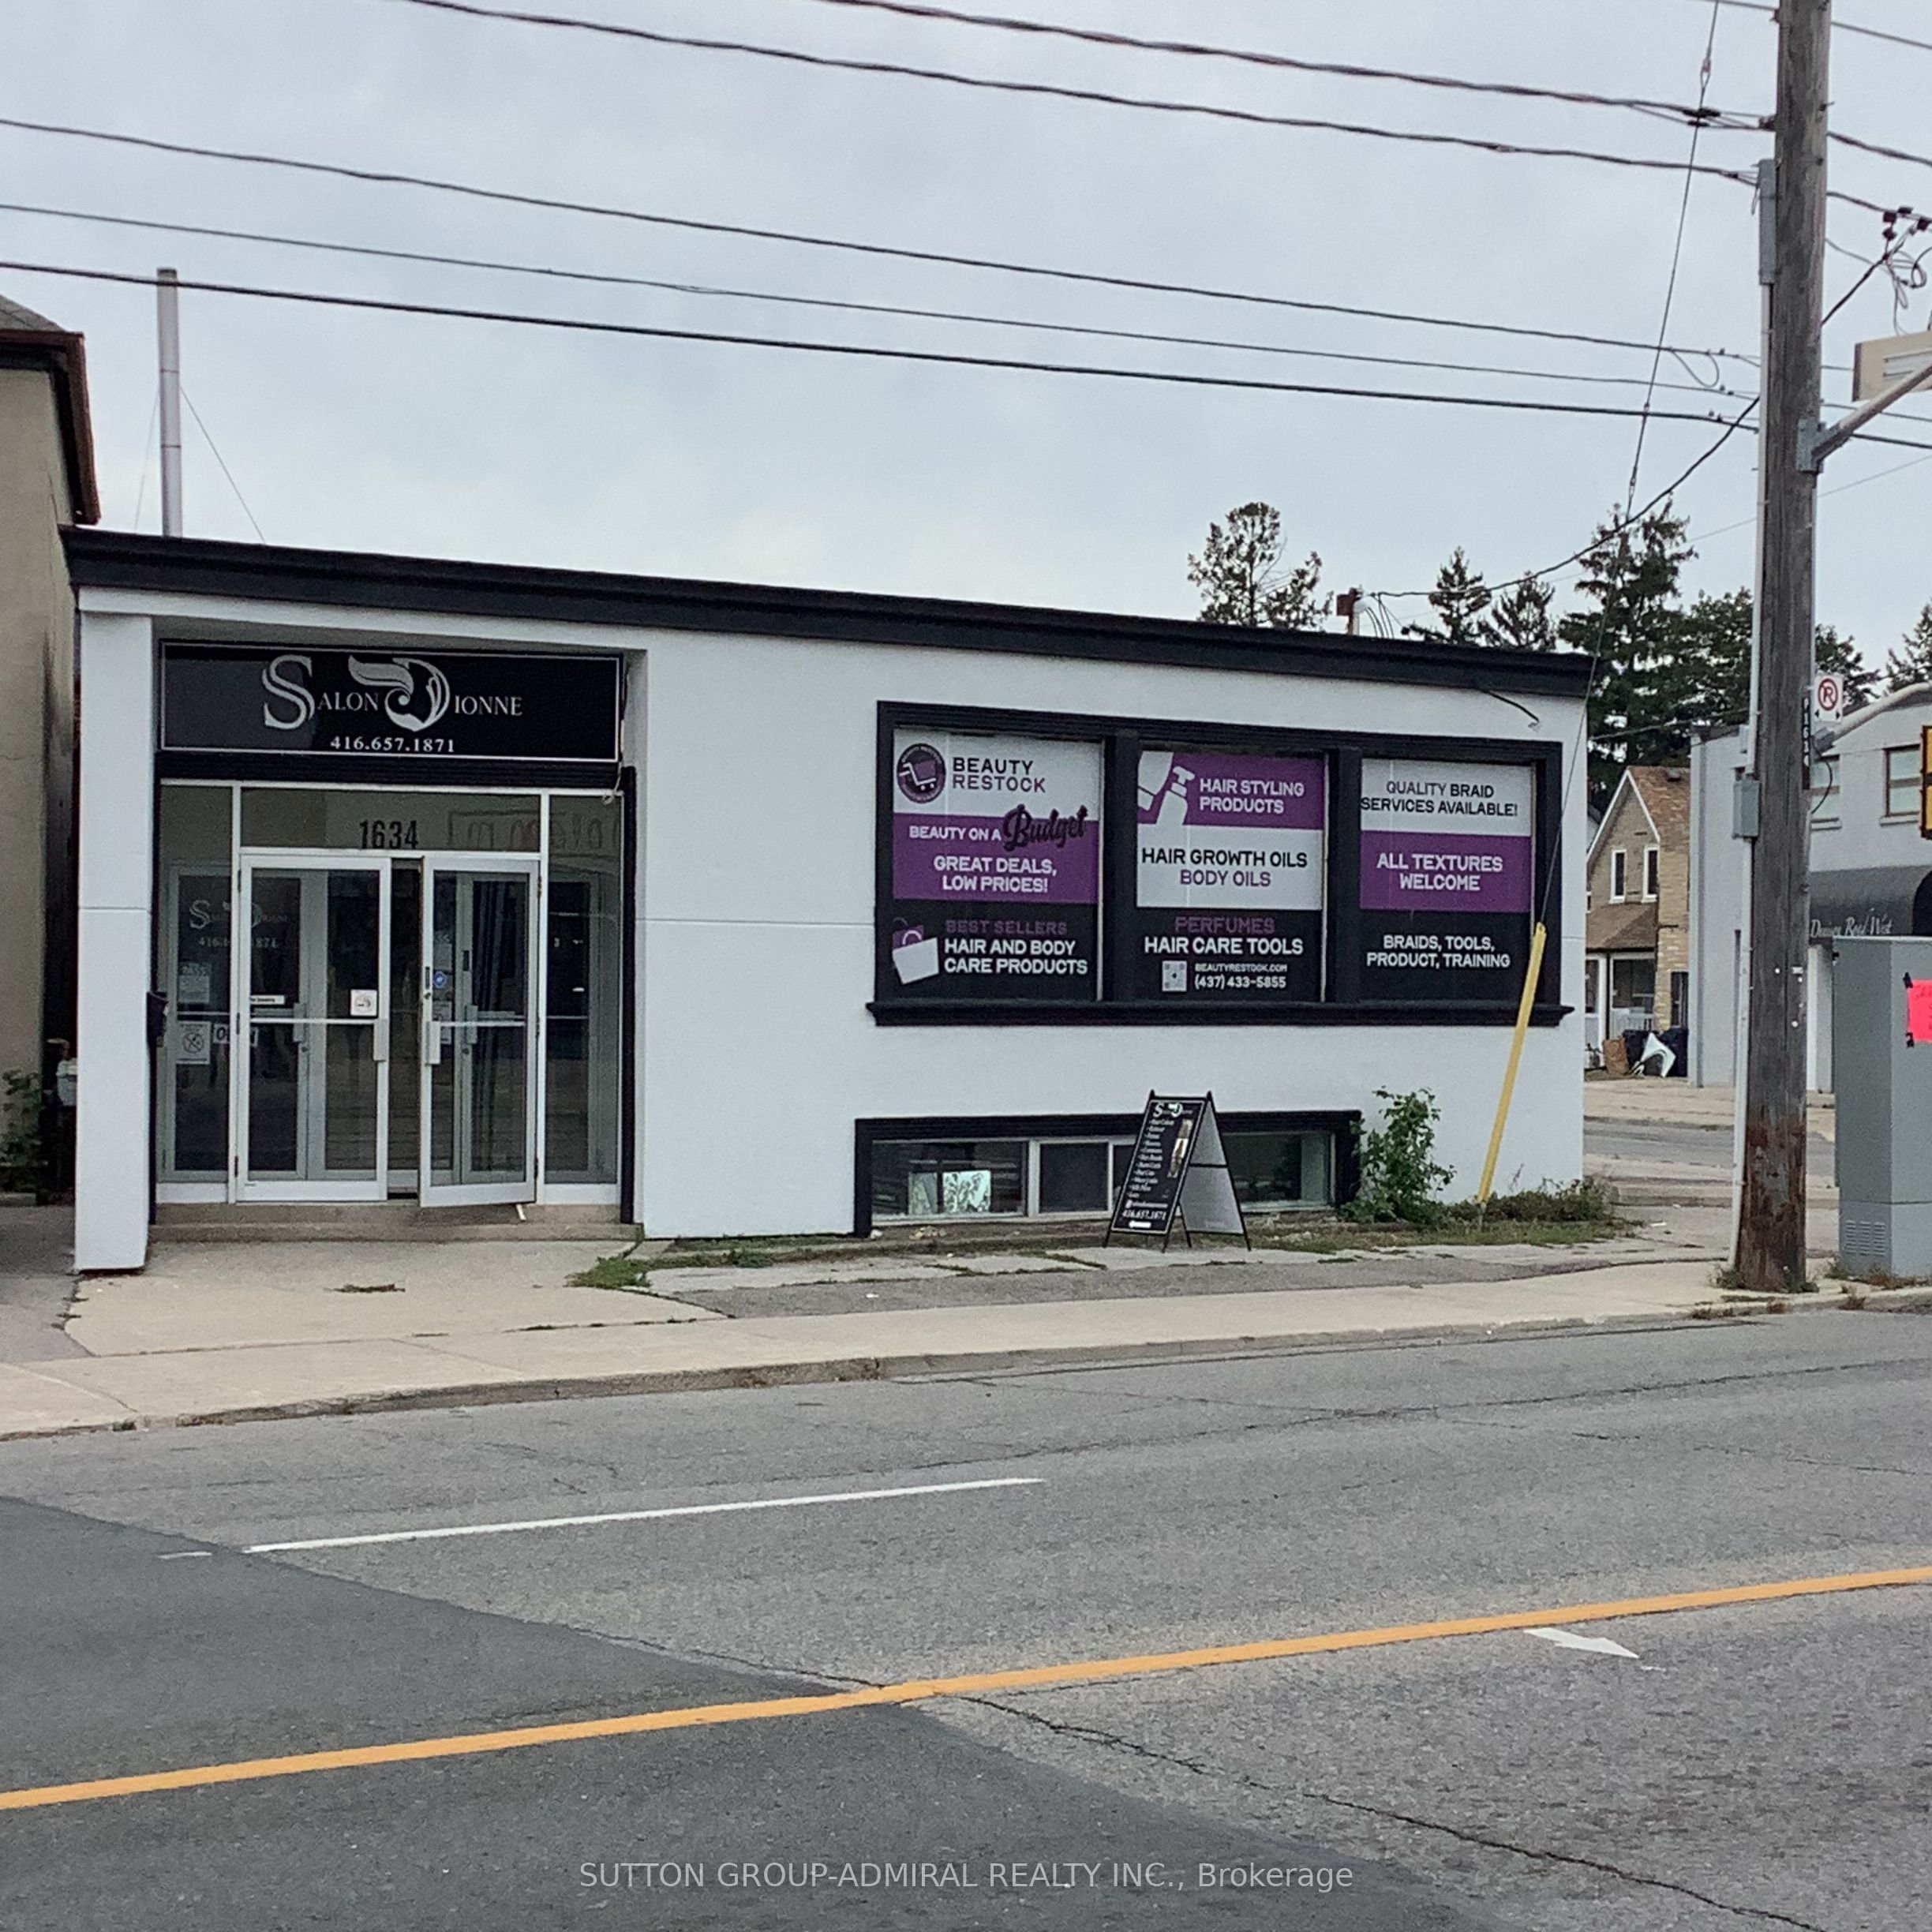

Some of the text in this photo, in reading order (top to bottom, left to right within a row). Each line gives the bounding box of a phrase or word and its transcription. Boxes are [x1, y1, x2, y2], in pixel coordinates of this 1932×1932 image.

[330, 736, 455, 754] 416.657.1871
[953, 757, 1033, 775] BEAUTY
[953, 775, 1046, 793] RESTOCK
[1200, 777, 1305, 797] HAIR STYLING
[1386, 781, 1494, 798] QUALITY BRAID
[1200, 796, 1284, 814] PRODUCTS
[1361, 797, 1518, 817] SERVICES AVAILABLE!
[359, 820, 419, 850] 1634
[909, 804, 1088, 851] BEAUTY ON A Budget
[934, 856, 1057, 876] GREAT DEALS,
[1142, 848, 1308, 868] HAIR GROWTH OILS
[1376, 853, 1503, 872] ALL TEXTURES
[942, 875, 1048, 893] LOW PRICES!
[1180, 870, 1271, 887] BODY OILS
[1399, 873, 1481, 891] WELCOME
[945, 920, 1067, 935] BEST SELLERS
[1174, 916, 1275, 934] PERFUMES
[945, 938, 1076, 955] HAIR AND BODY
[1144, 937, 1304, 955] HAIR CARE TOOLS
[1383, 935, 1496, 953] BRAIDS, TOOLS,
[945, 958, 1088, 974] CARE PRODUCTS
[1366, 953, 1511, 970] PRODUCT, TRAINING
[1195, 975, 1225, 990] (437)
